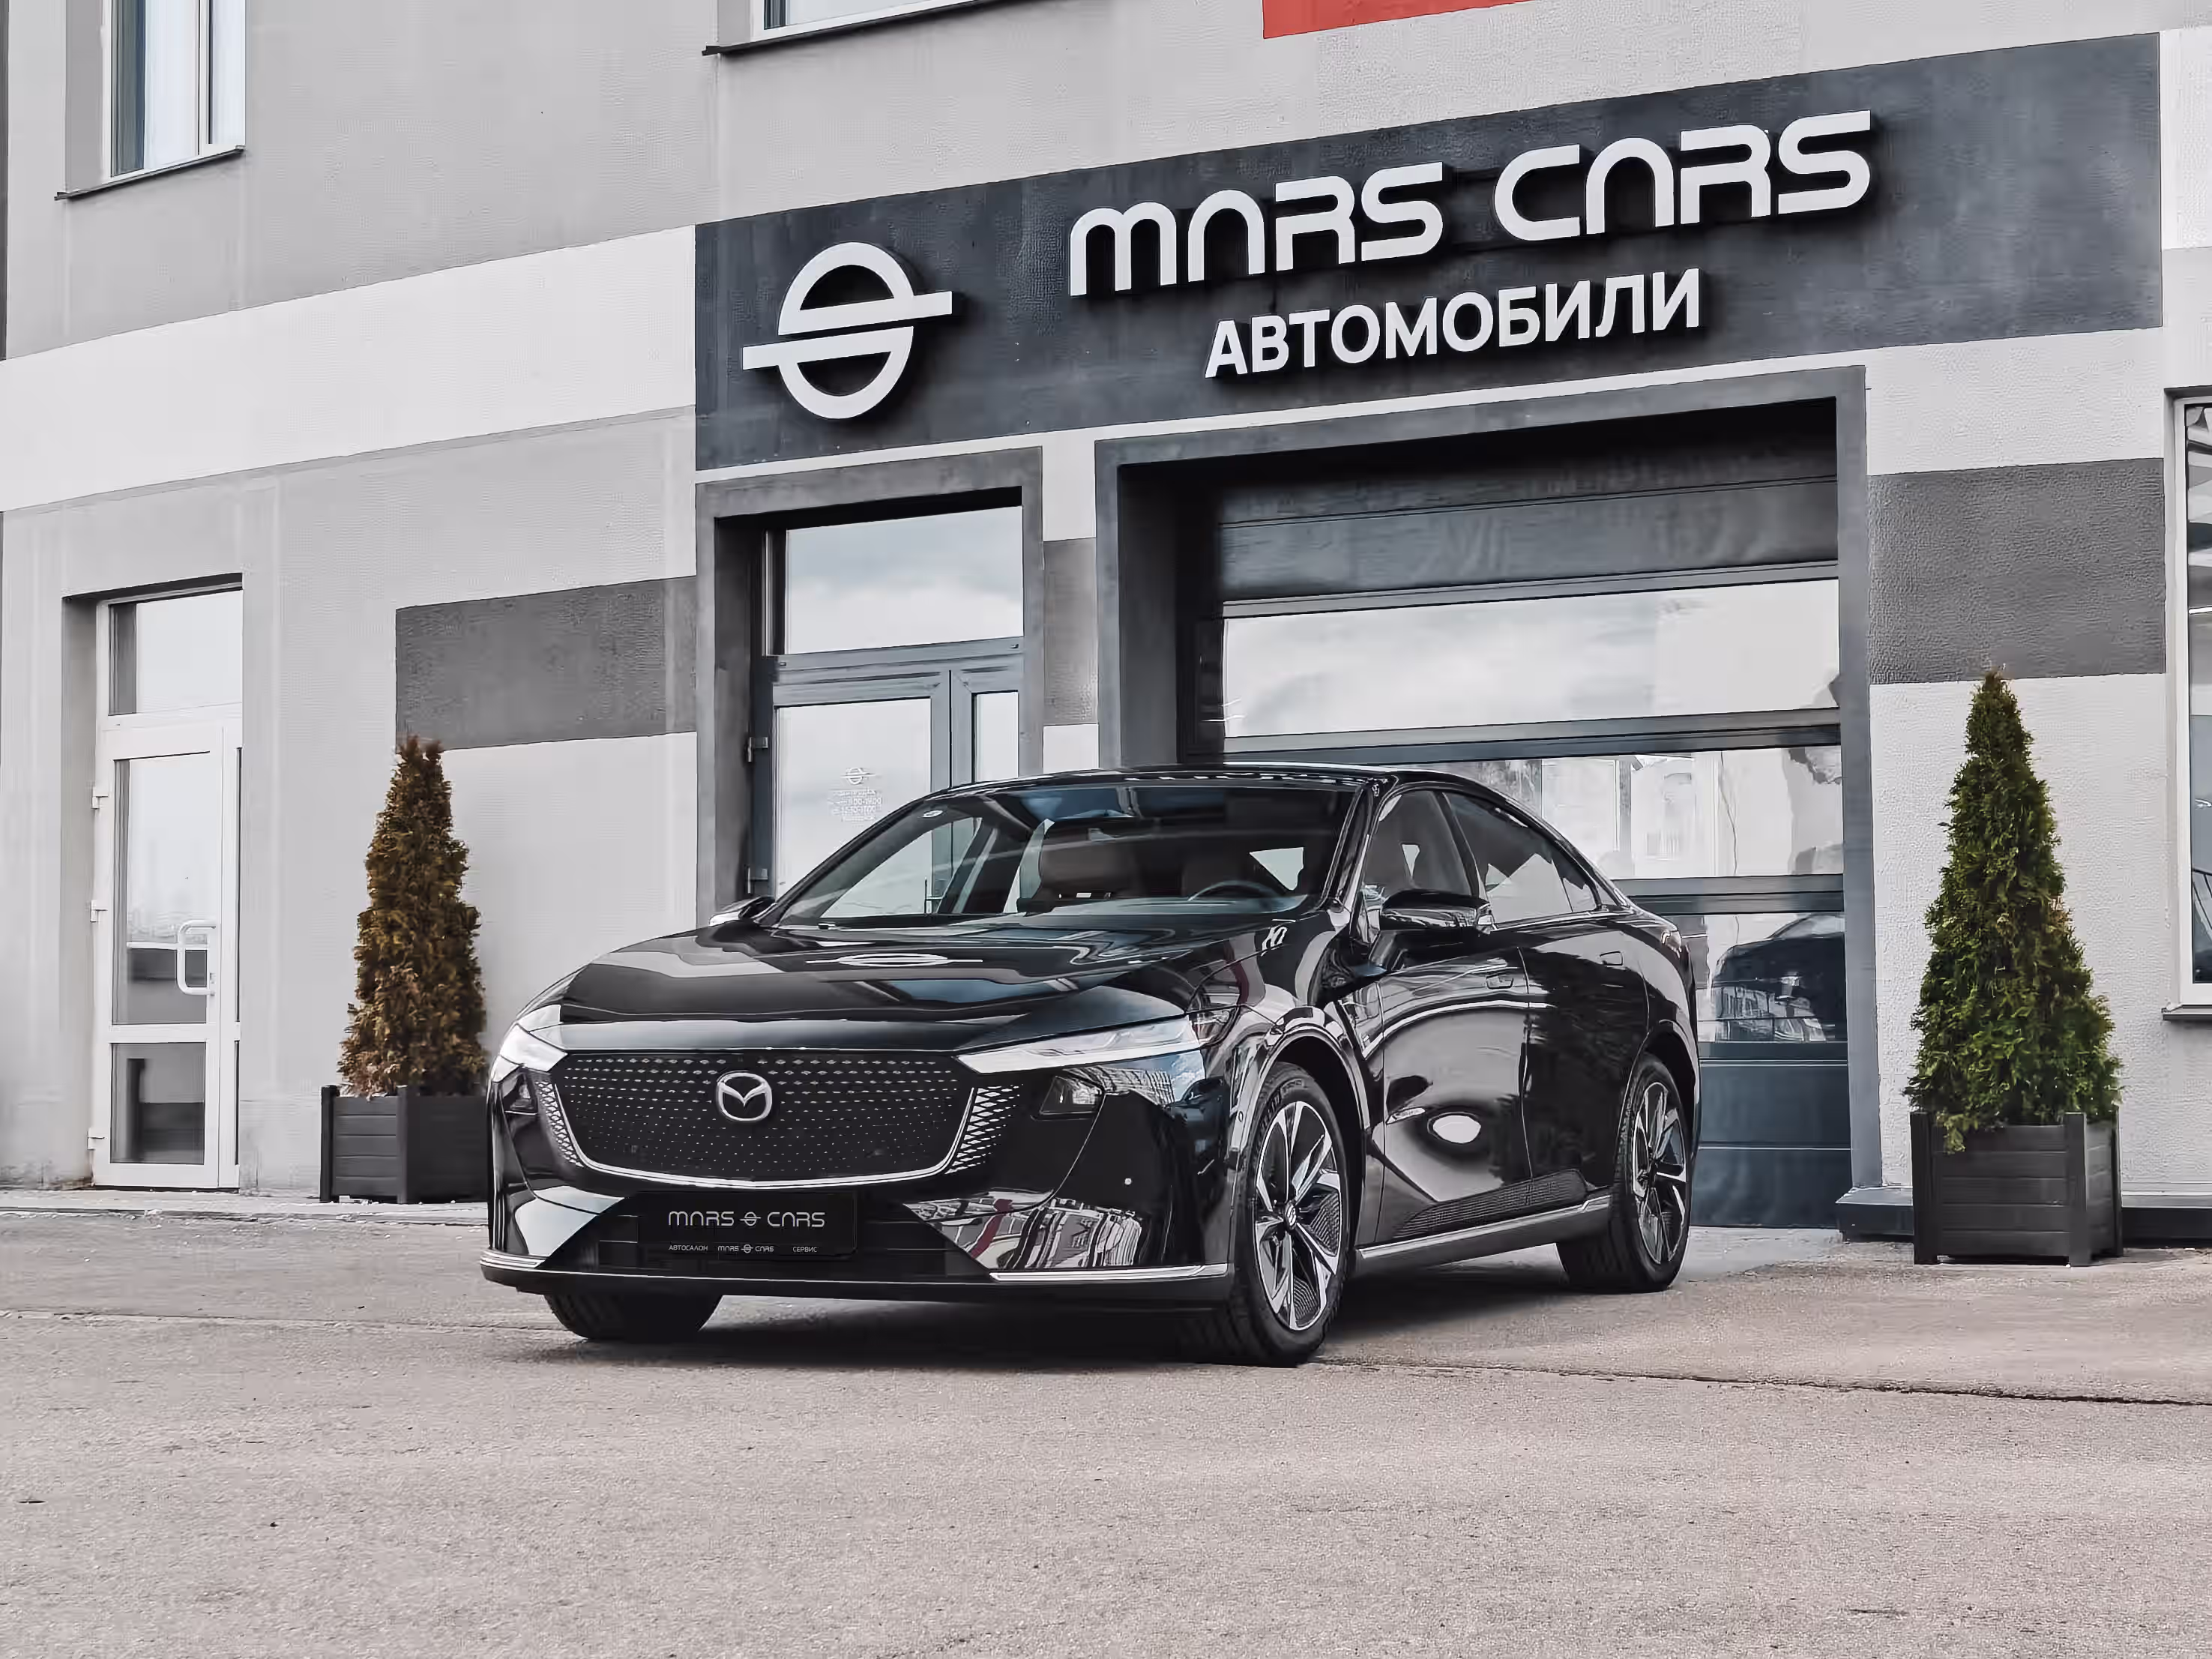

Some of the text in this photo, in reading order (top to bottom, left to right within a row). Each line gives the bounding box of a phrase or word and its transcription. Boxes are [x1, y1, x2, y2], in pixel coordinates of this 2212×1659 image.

[1069, 109, 1871, 296] MARS CARS
[1205, 268, 1700, 379] АВТОМОБИЛИ
[668, 1211, 825, 1228] MARS CARS
